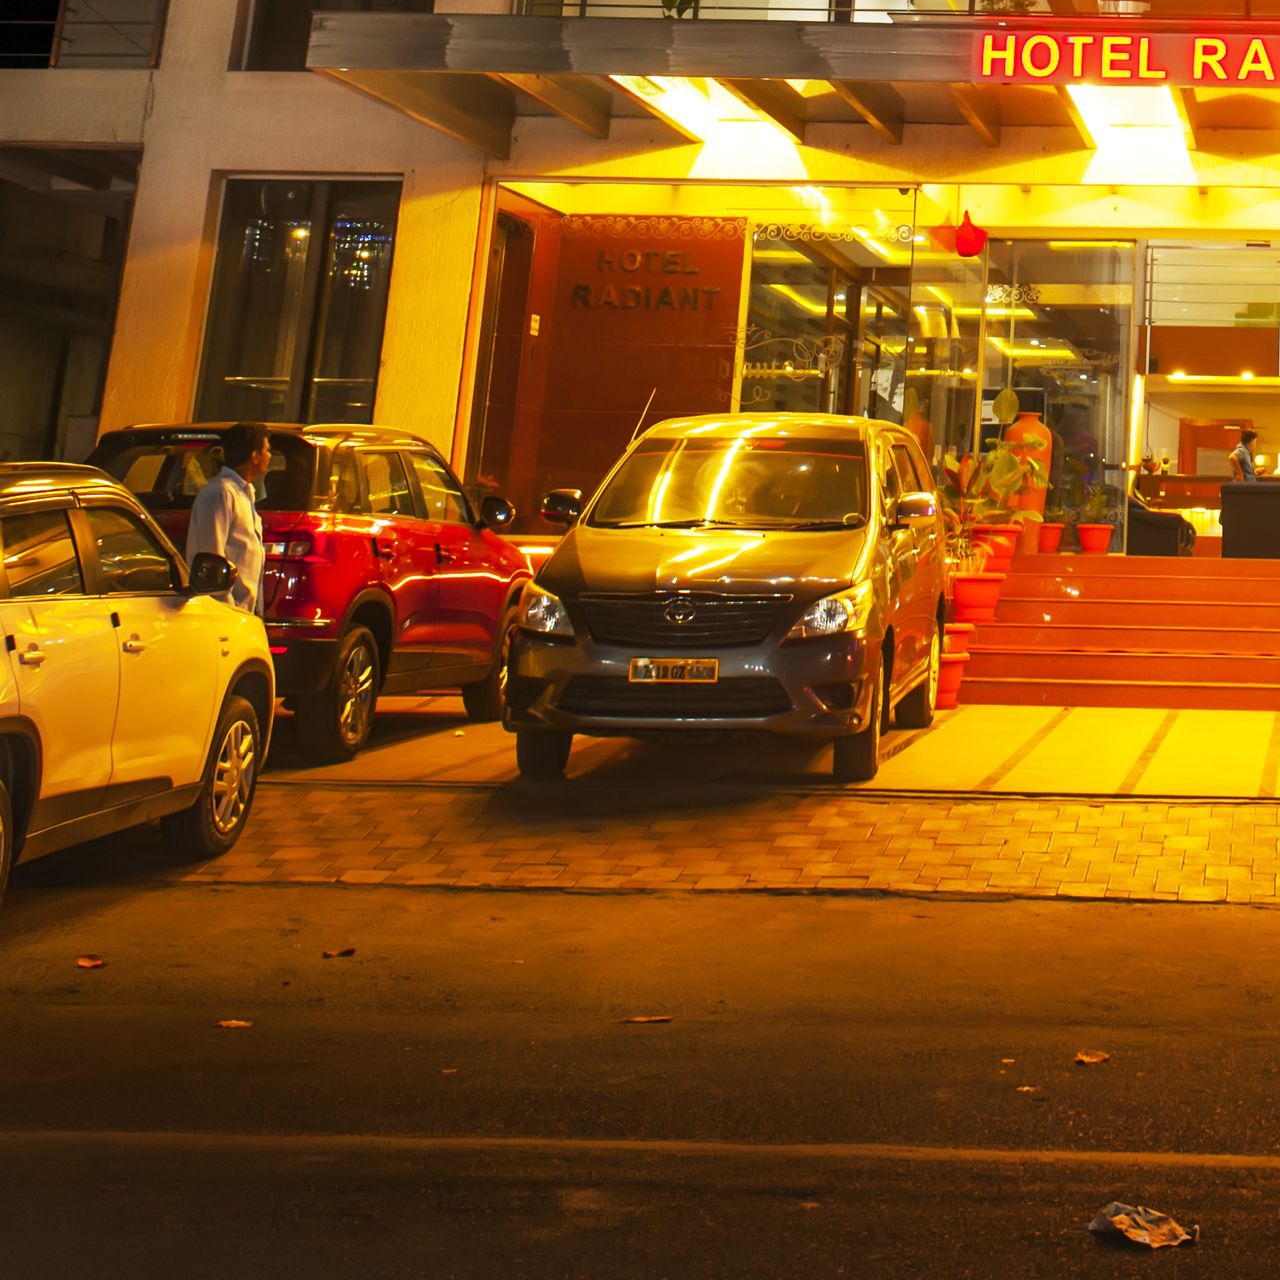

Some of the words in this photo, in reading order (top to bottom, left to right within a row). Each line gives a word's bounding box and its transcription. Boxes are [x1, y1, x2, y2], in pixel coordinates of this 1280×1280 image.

[981, 34, 1167, 80] HOTEL
[595, 248, 701, 276] HOTEL
[571, 284, 721, 312] RADIANT
